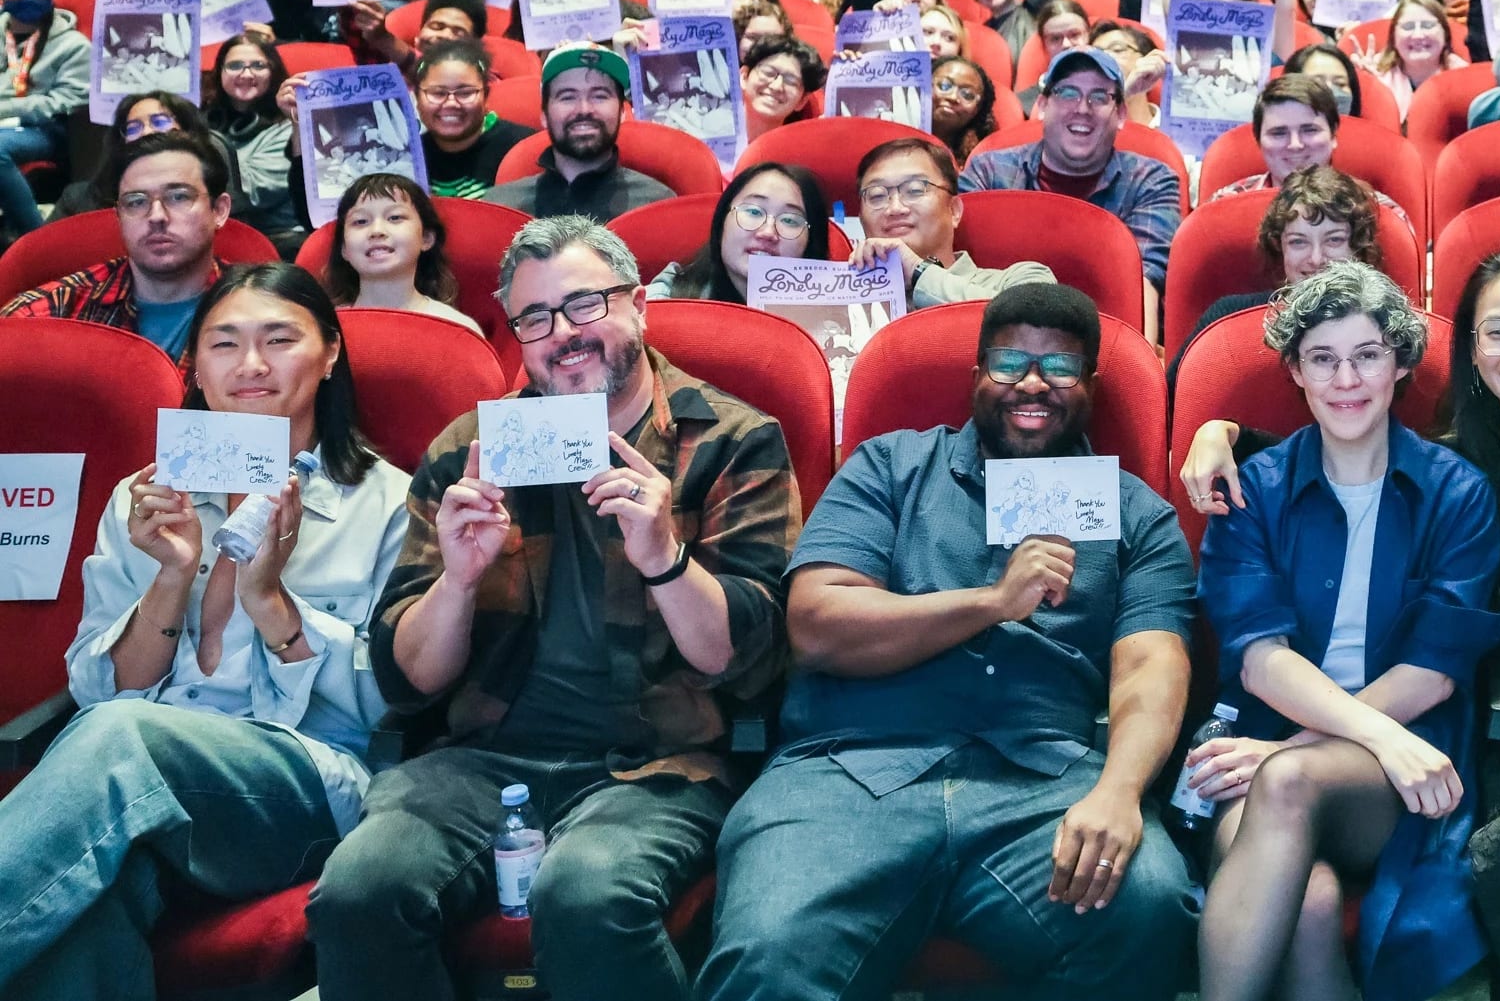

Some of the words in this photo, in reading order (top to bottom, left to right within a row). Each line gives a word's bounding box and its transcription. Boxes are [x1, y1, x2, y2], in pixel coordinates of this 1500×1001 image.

[680, 22, 725, 45] Magic
[877, 58, 922, 81] Magic
[305, 75, 354, 100] Lonely
[353, 72, 397, 94] Magic
[758, 268, 825, 300] Lonely
[824, 267, 891, 298] Magic
[2, 488, 54, 507] VED
[0, 532, 50, 545] Burns
